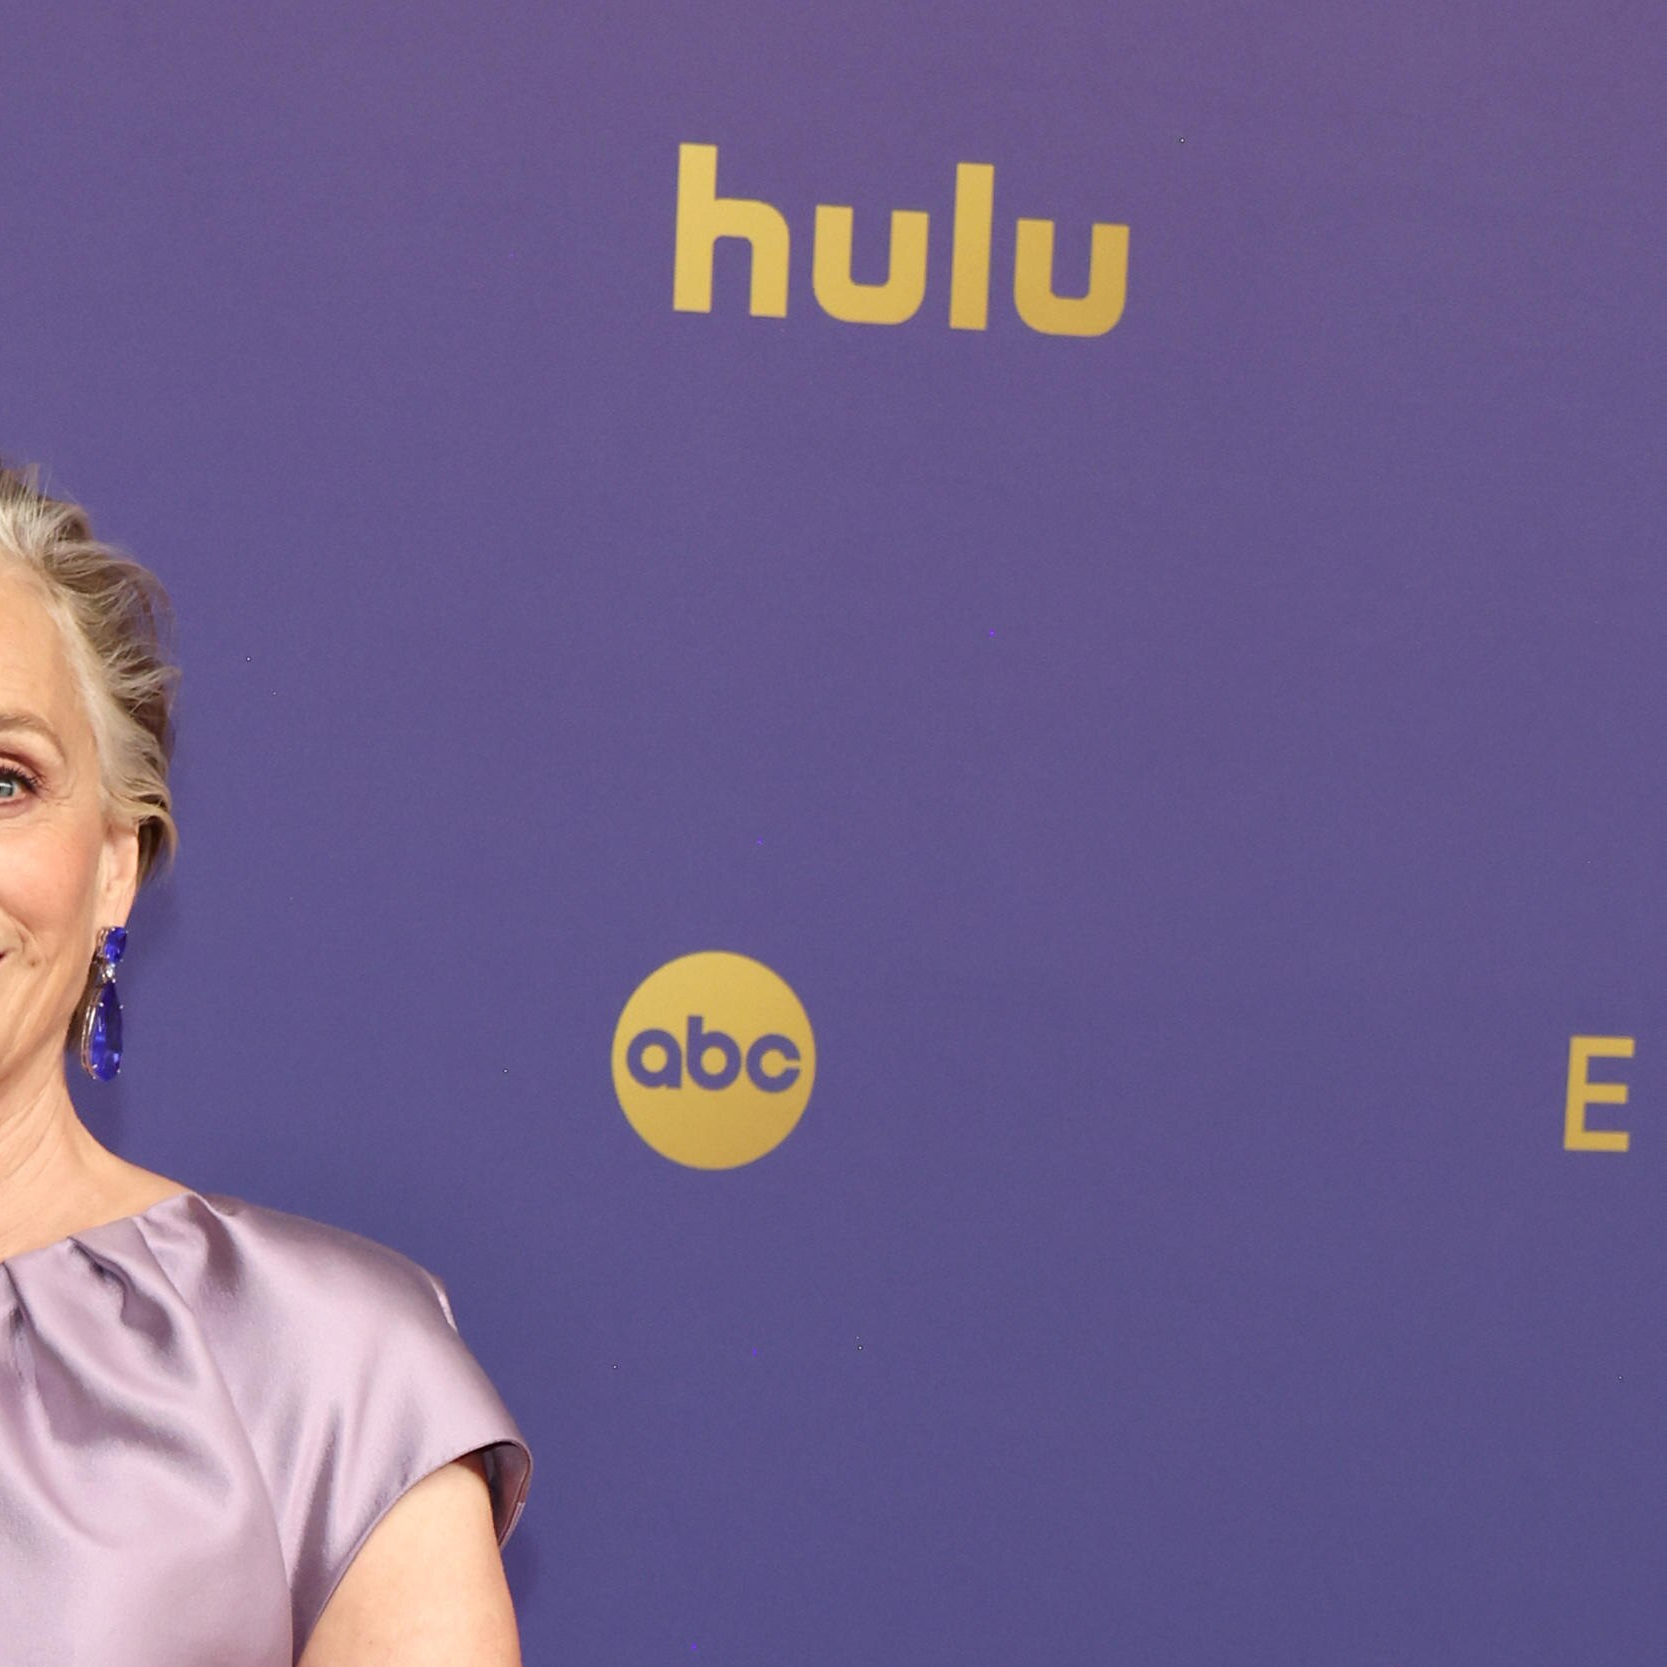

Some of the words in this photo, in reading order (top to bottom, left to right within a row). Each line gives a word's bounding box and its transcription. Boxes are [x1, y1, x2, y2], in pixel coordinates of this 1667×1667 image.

[672, 142, 1130, 337] hulu
[626, 1015, 802, 1094] abc
[1564, 1035, 1636, 1152] E
